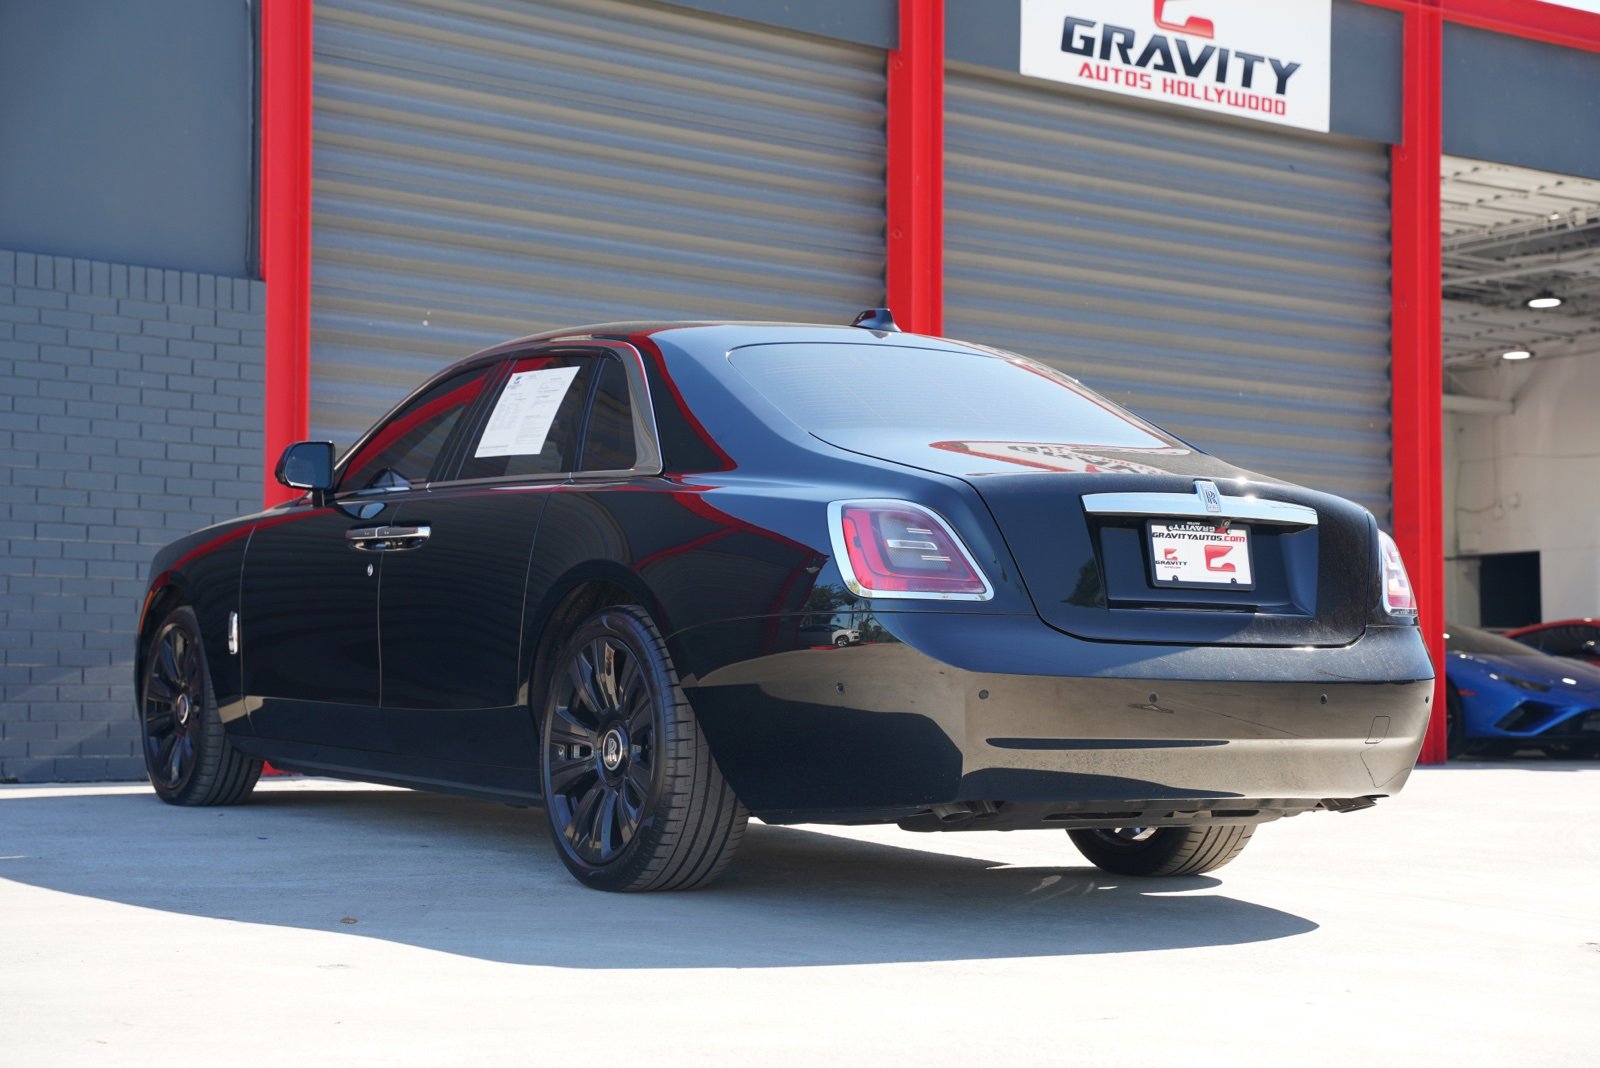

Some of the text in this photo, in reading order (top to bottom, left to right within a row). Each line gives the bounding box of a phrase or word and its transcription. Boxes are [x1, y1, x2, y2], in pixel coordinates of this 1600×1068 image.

[1061, 16, 1301, 95] GRAVITY
[1078, 62, 1287, 116] AUTOS HOLLYWOOD
